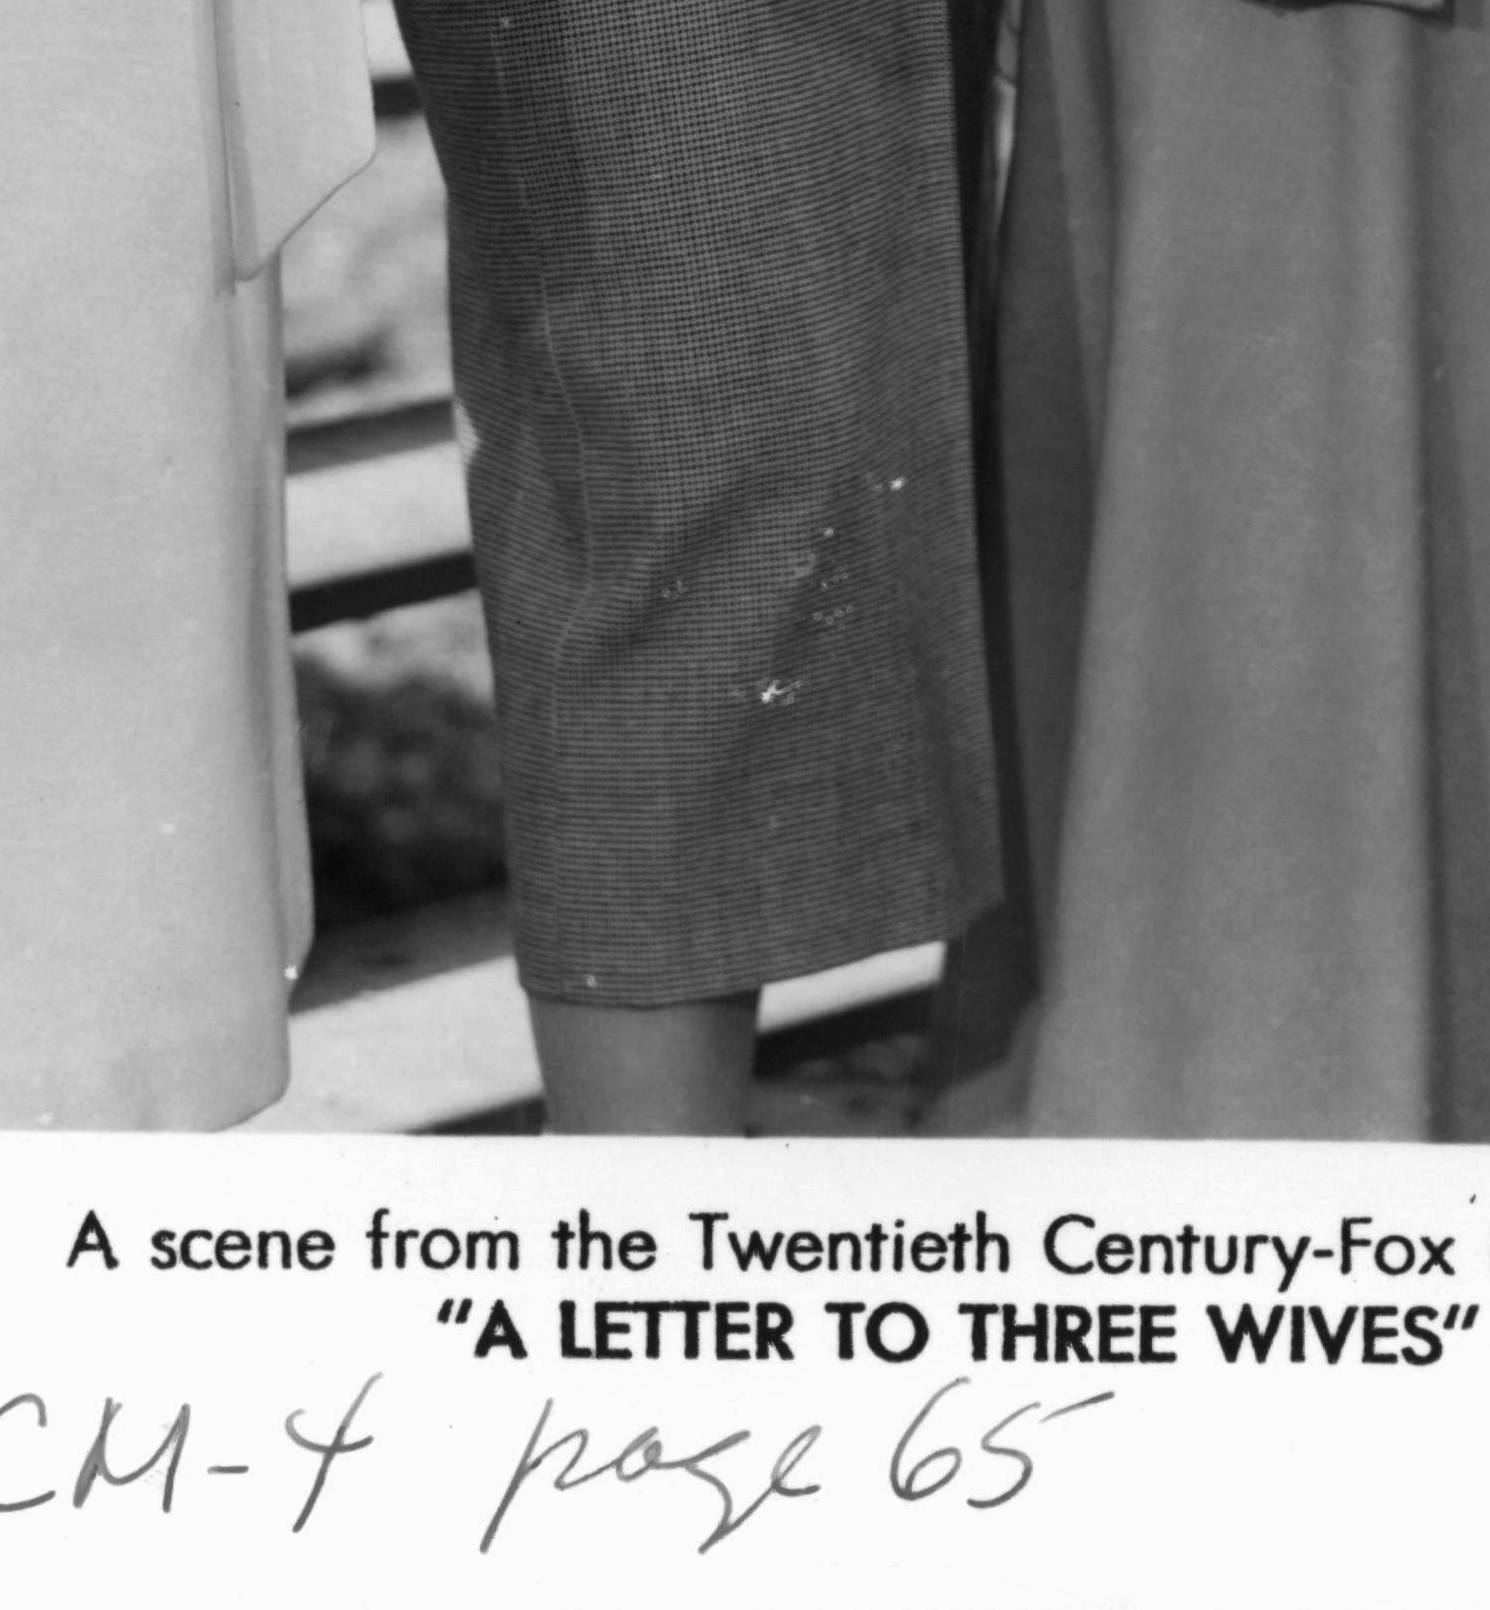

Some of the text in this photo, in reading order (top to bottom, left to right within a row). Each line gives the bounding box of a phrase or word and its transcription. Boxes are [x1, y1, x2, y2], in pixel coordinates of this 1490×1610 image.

[67, 1210, 119, 1271] A
[151, 1230, 335, 1272] scene
[366, 1208, 519, 1271] from
[551, 1208, 657, 1272] the
[689, 1210, 1010, 1274] Twentieth
[1043, 1213, 1455, 1293] Century-Fox
[559, 1300, 794, 1361] LETTER
[824, 1301, 929, 1363] TO
[958, 1303, 1177, 1364] THREE
[480, 1397, 821, 1555] page
[889, 1377, 1114, 1509] 65
